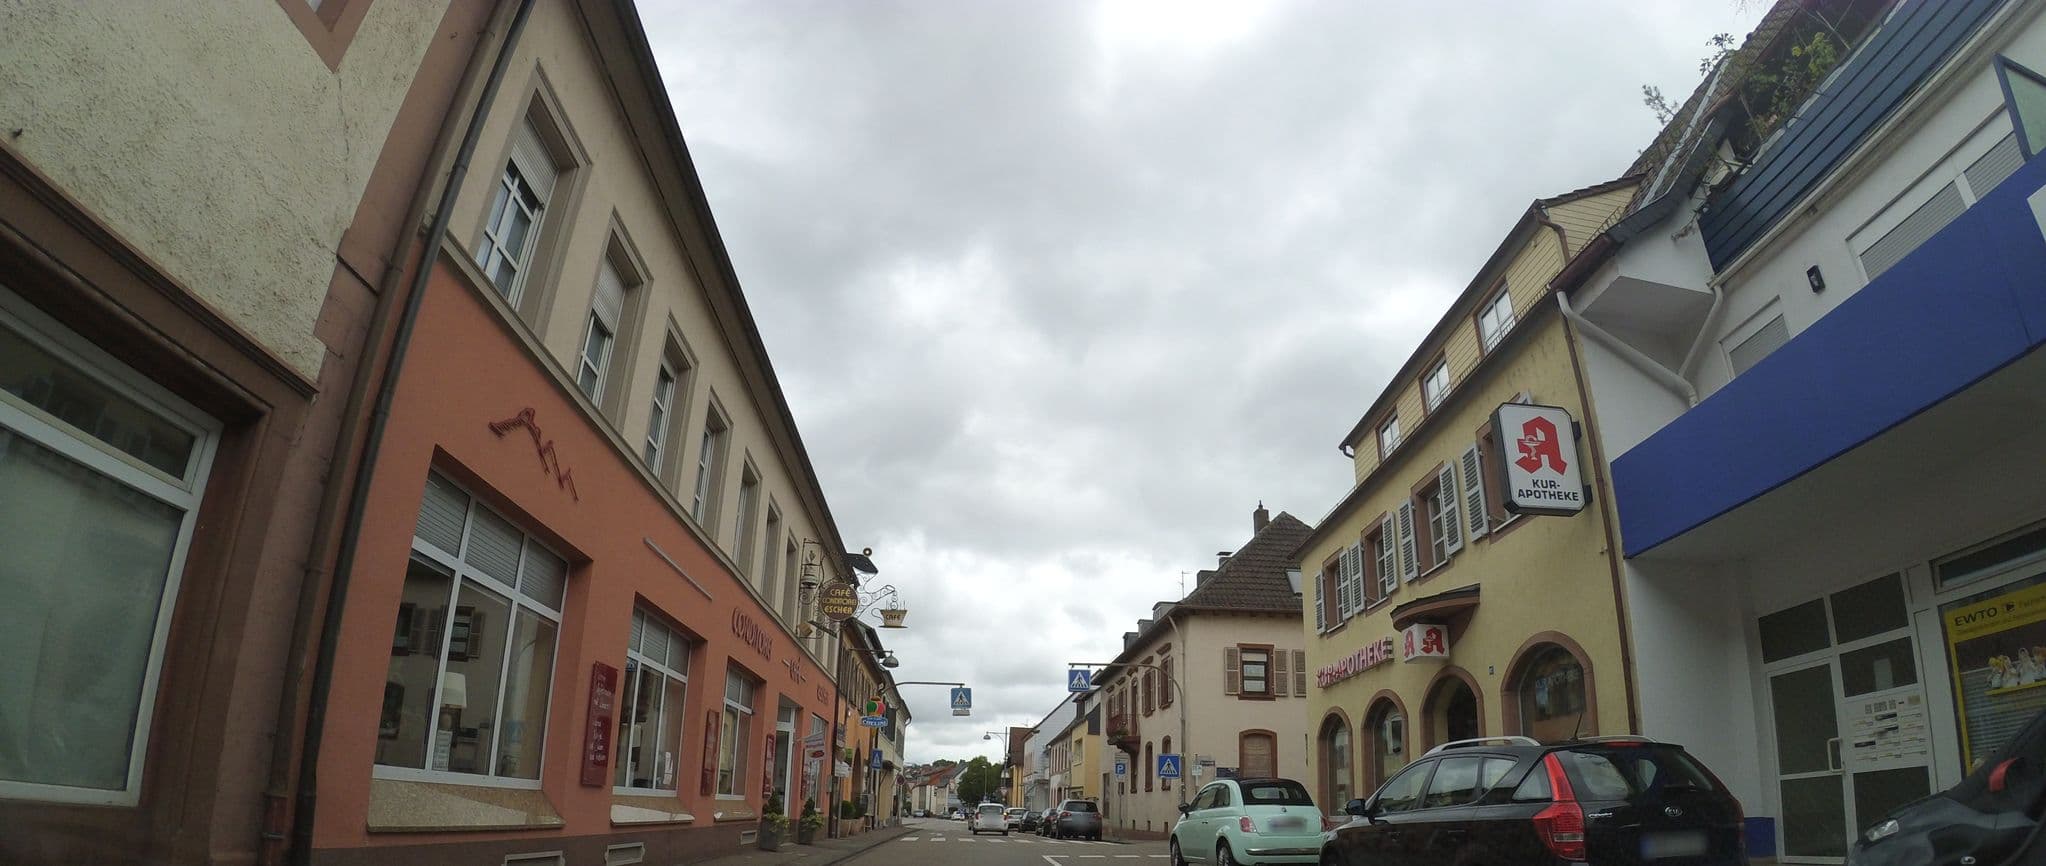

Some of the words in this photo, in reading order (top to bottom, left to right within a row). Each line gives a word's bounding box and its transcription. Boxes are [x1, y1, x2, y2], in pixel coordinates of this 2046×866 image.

[1531, 478, 1561, 490] KUR-
[1517, 488, 1580, 502] APOTHEKE
[824, 605, 852, 614] ESCHER
[1954, 607, 1998, 627] EWTO
